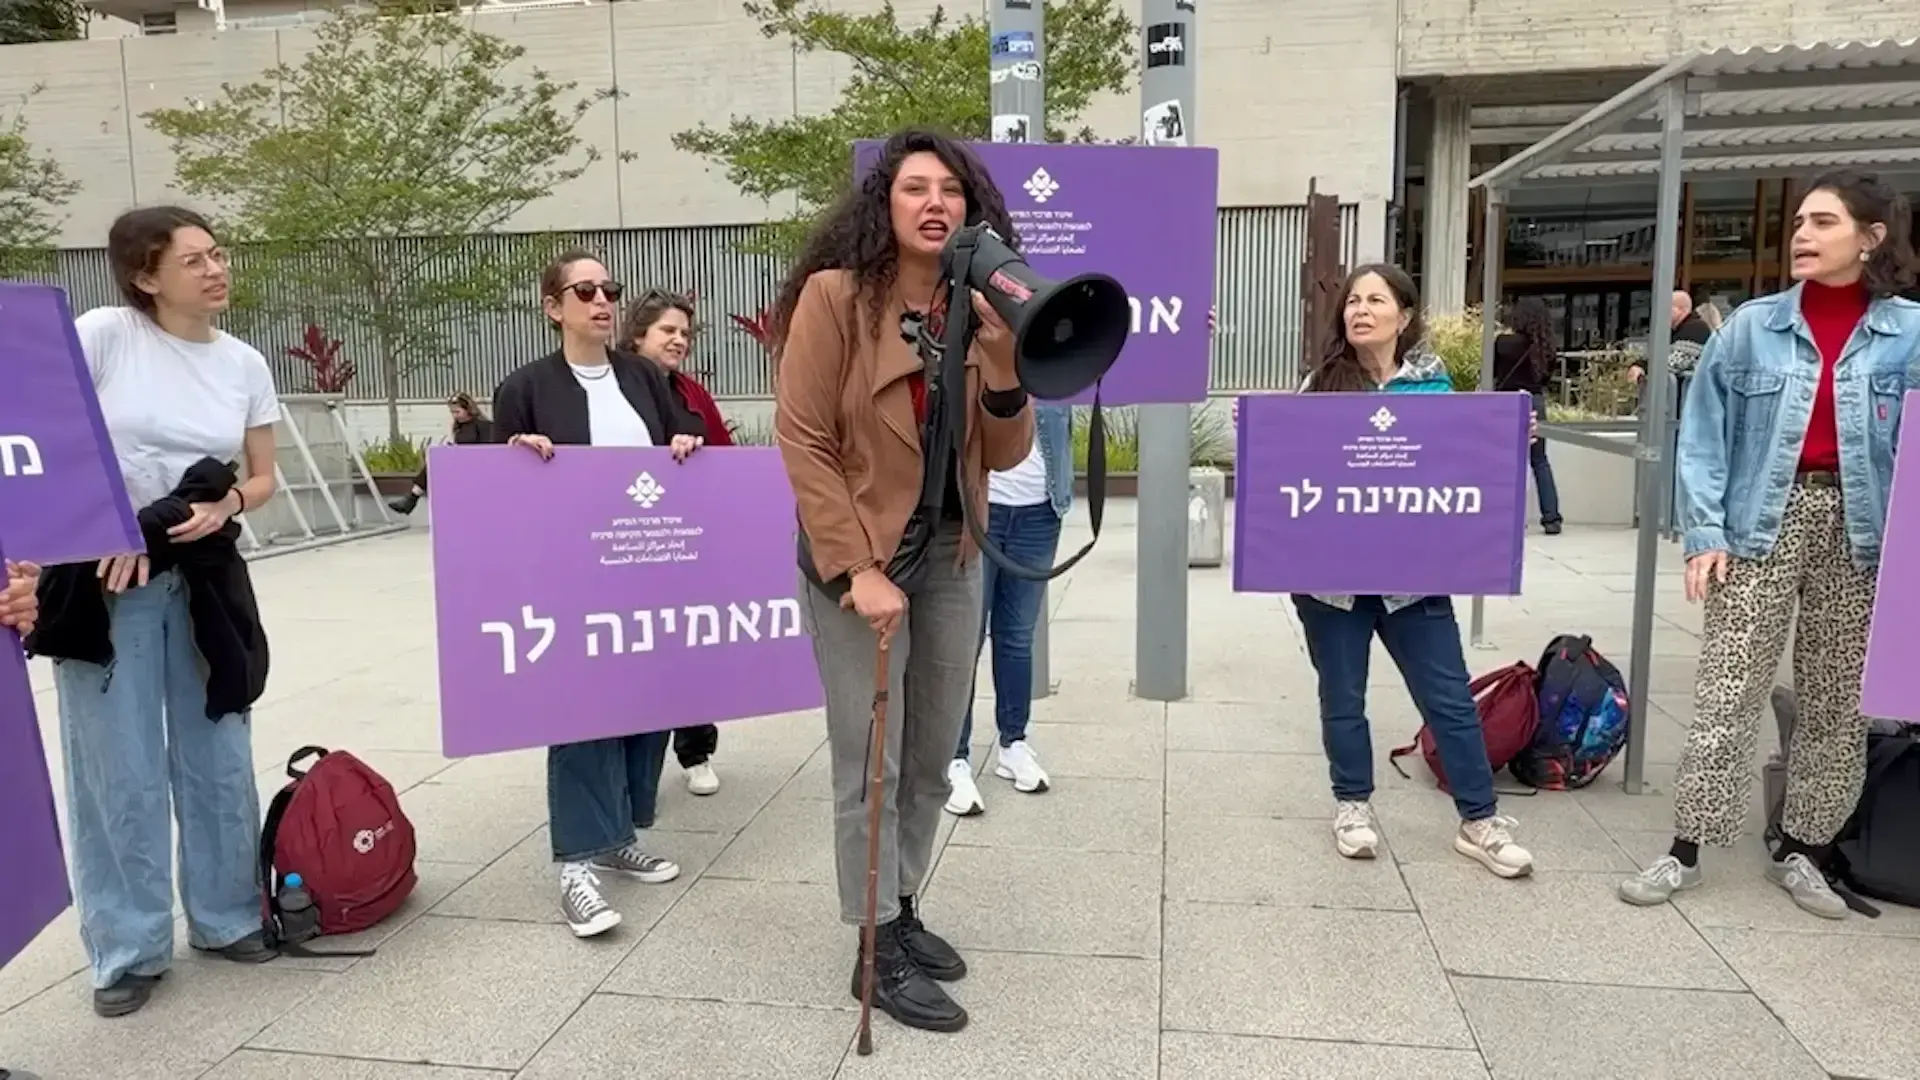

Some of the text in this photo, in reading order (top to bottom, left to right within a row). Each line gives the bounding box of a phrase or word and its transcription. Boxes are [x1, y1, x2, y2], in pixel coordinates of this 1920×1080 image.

[1279, 478, 1481, 518] מאמינה לך
[481, 597, 802, 674] מאמינה לך
